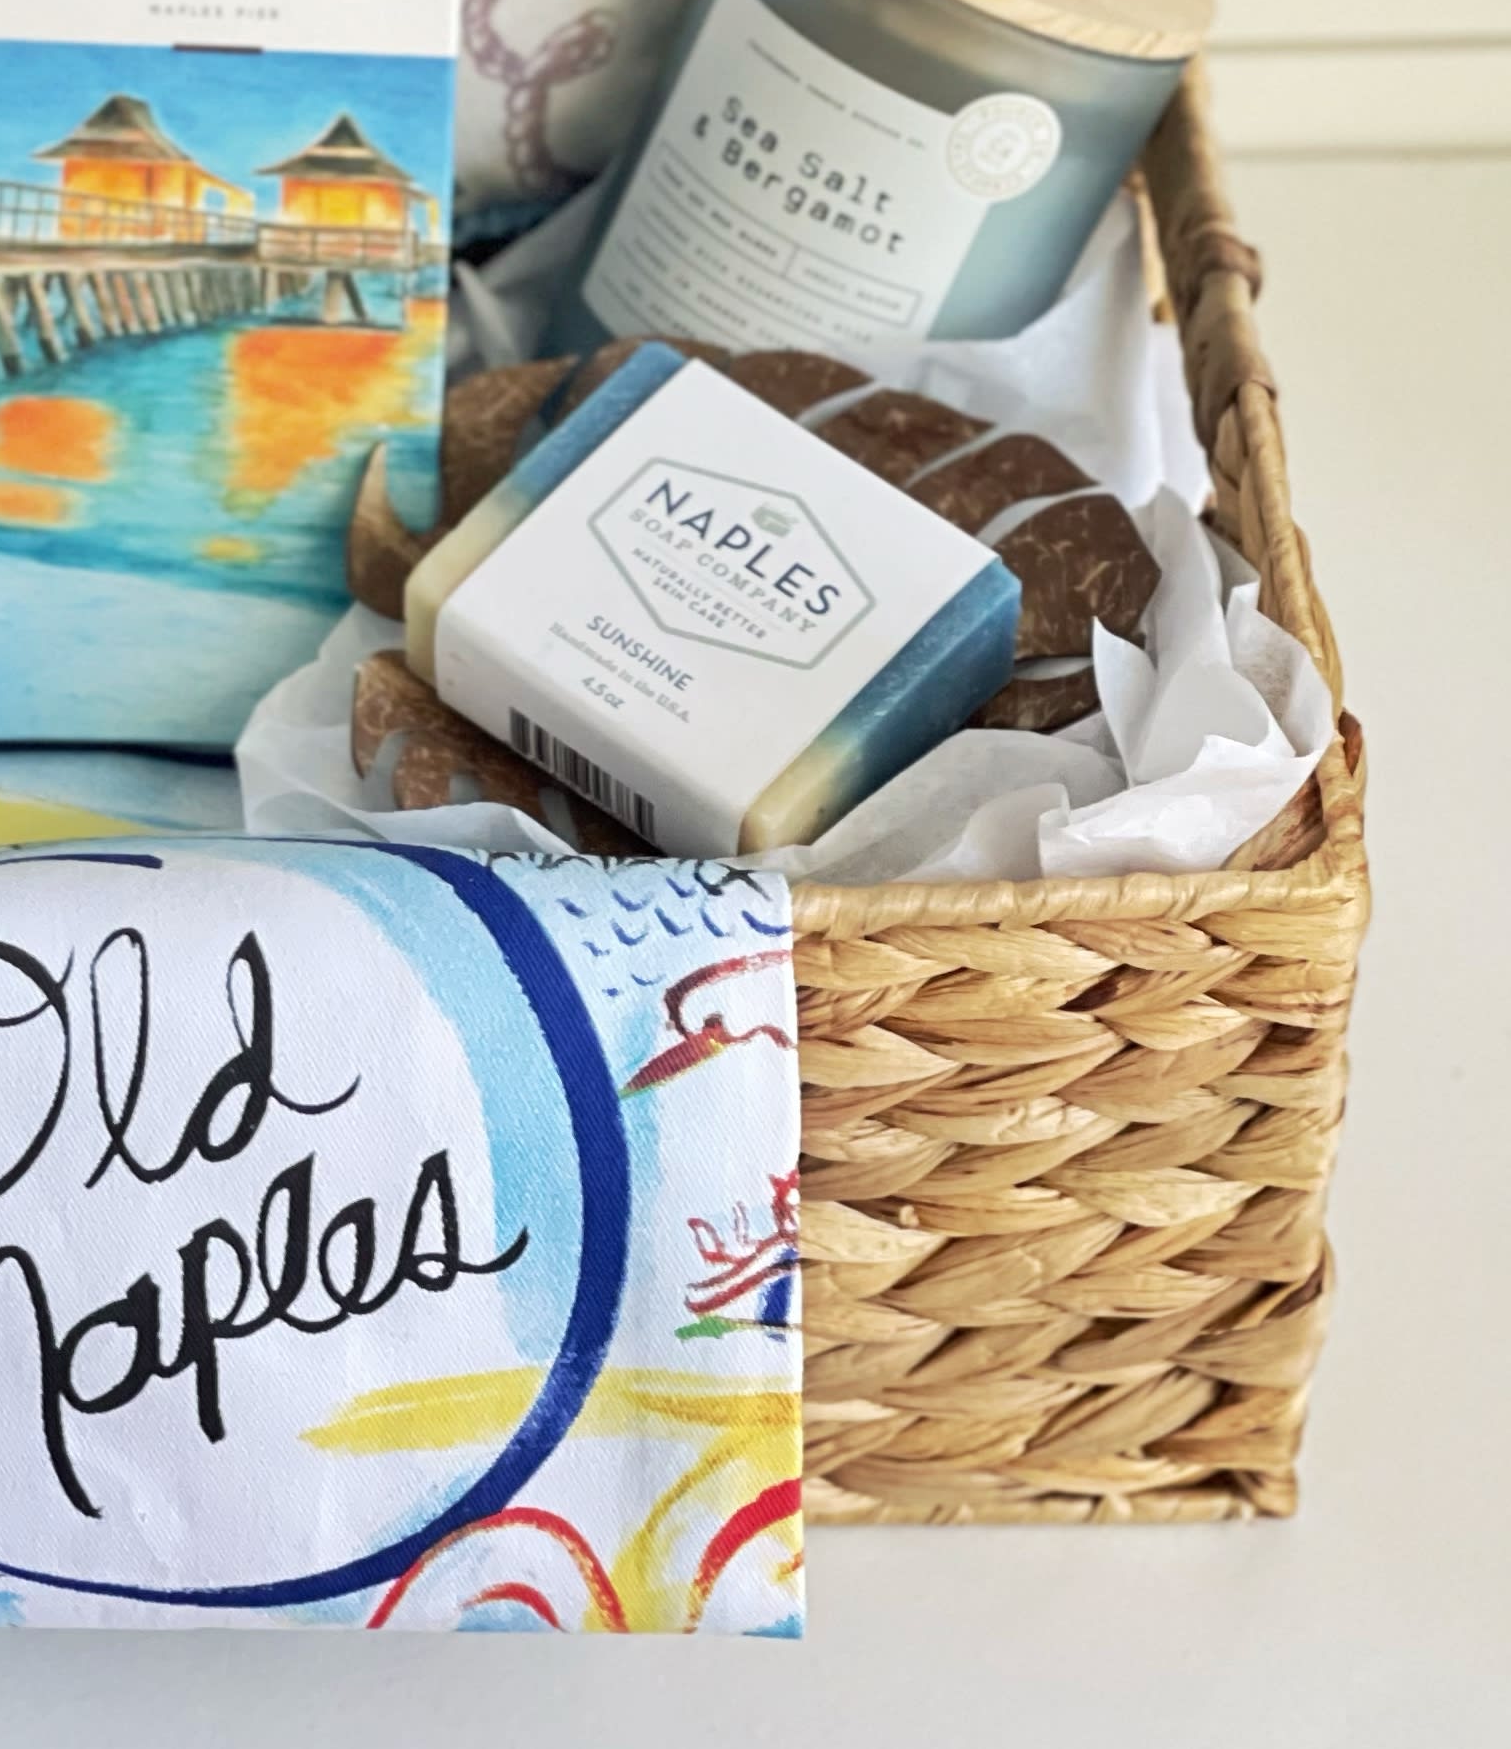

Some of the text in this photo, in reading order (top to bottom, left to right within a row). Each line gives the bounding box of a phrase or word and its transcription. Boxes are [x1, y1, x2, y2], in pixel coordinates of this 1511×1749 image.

[720, 96, 779, 154] Sea
[797, 151, 895, 215] Salt
[720, 136, 906, 254] Bergamot
[628, 507, 818, 633] SOAP COMPANY
[631, 547, 768, 640] NATURALLY BETTER
[644, 478, 842, 616] NAPLES
[652, 577, 726, 629] SKIN CARE
[548, 621, 619, 673] Handmade
[617, 668, 634, 684] in
[634, 679, 656, 698] the
[586, 614, 694, 691] SUNSHINE
[603, 692, 627, 709] oz
